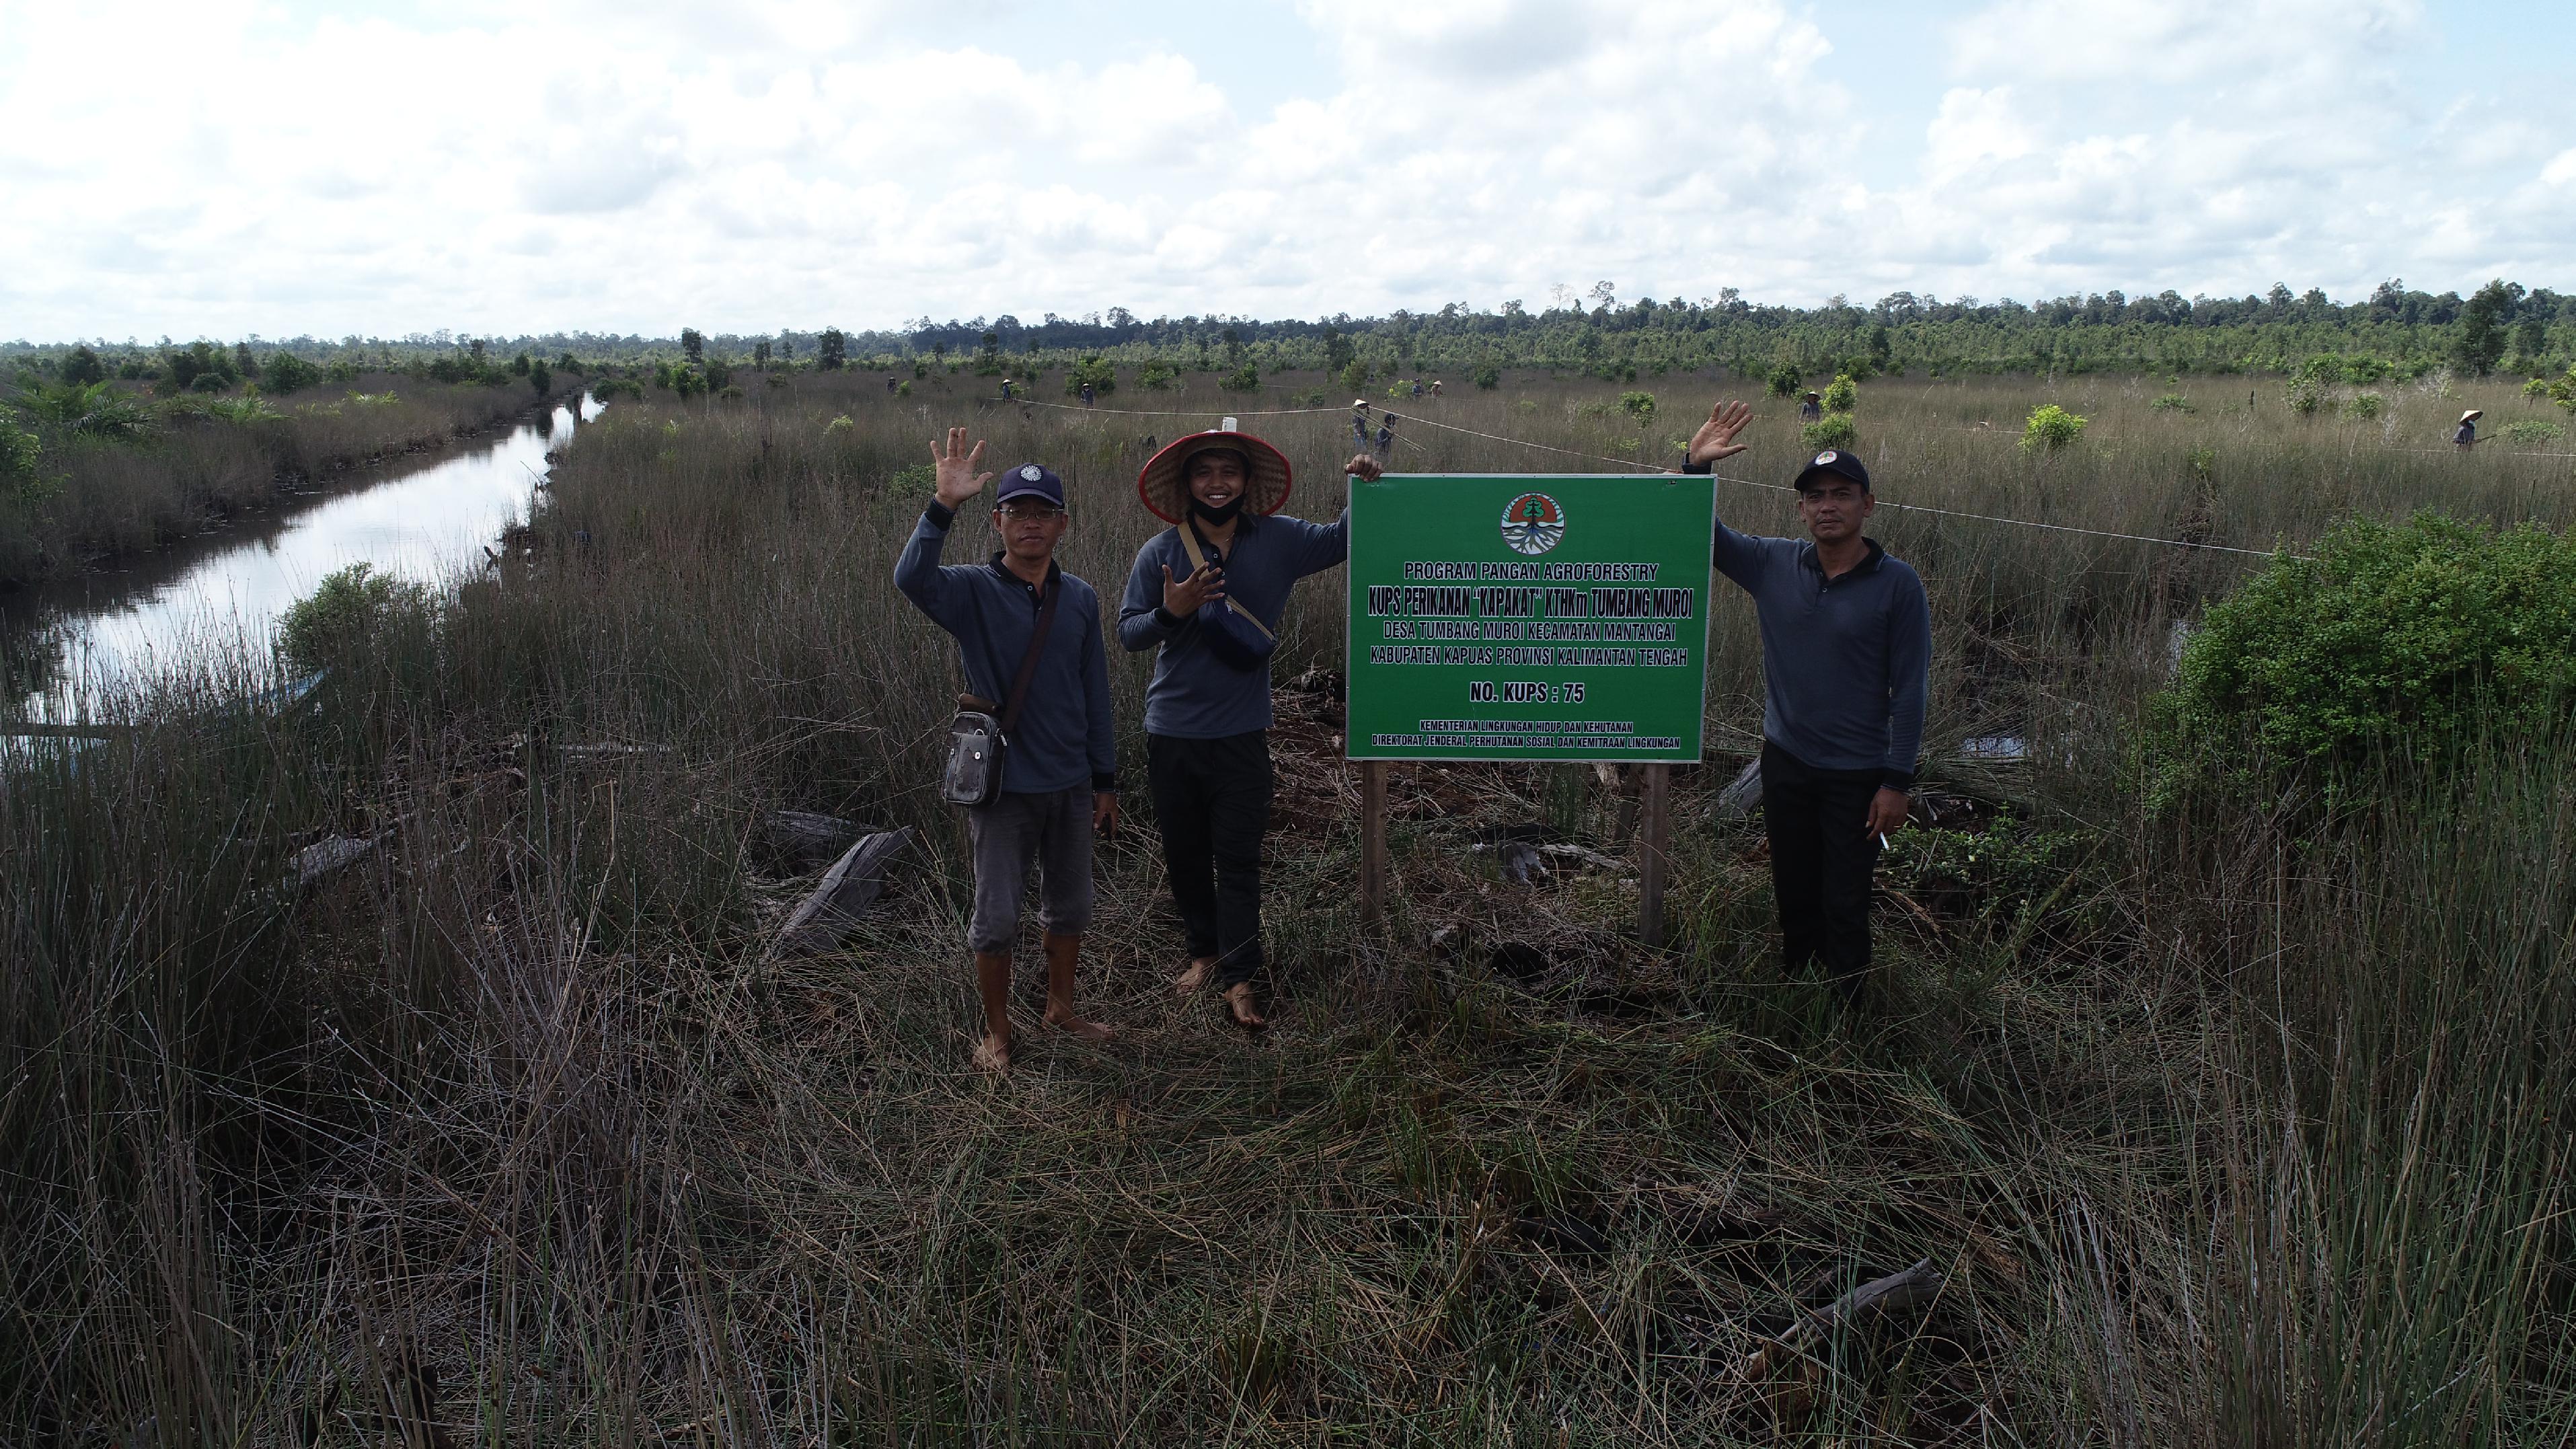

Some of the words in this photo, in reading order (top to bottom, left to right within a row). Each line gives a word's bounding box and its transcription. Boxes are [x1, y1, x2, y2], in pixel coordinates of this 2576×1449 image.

[1404, 562, 1476, 580] PROGRAM
[1481, 562, 1539, 581] PANGAN
[1543, 562, 1659, 581] AGROFORESTRY
[1368, 585, 1401, 616] KUPS
[1403, 586, 1471, 617] PERIKANAN
[1544, 587, 1588, 618] KTHKm
[1591, 588, 1650, 619] TUMBANG
[1652, 588, 1694, 619] MUROI
[1384, 621, 1415, 639] DESA
[1418, 621, 1479, 640] TUMBANG
[1483, 622, 1524, 640] MUROI
[1527, 622, 1600, 641] KECAMATAN
[1603, 622, 1676, 641] MANTANGAI
[1370, 646, 1441, 665] KABUPATEN
[1444, 646, 1492, 665] KAPUAS
[1496, 646, 1554, 665] PROVINSI
[1557, 647, 1636, 666] KALIMANTAN
[1638, 648, 1688, 666] TENGAH
[1470, 681, 1499, 702] NO.
[1503, 681, 1547, 702] KUPS
[1552, 687, 1558, 702] :
[1563, 682, 1585, 703] 75
[1419, 719, 1479, 732] KEMENTERIAN
[1480, 720, 1533, 733] LINGKUNGAN
[1536, 720, 1562, 733] HIDUP
[1564, 721, 1581, 733] DAN
[1583, 721, 1633, 734] KEHUTANAN
[1372, 734, 1423, 746] DIREKTORAT
[1425, 735, 1468, 747] JENDERAL
[1468, 735, 1525, 747] PERHUTANAN
[1525, 735, 1555, 748] SOSIAL
[1558, 736, 1576, 748] DAN
[1577, 736, 1626, 749] KEMITRAAN
[1627, 737, 1680, 749] LINGKUNGAN
